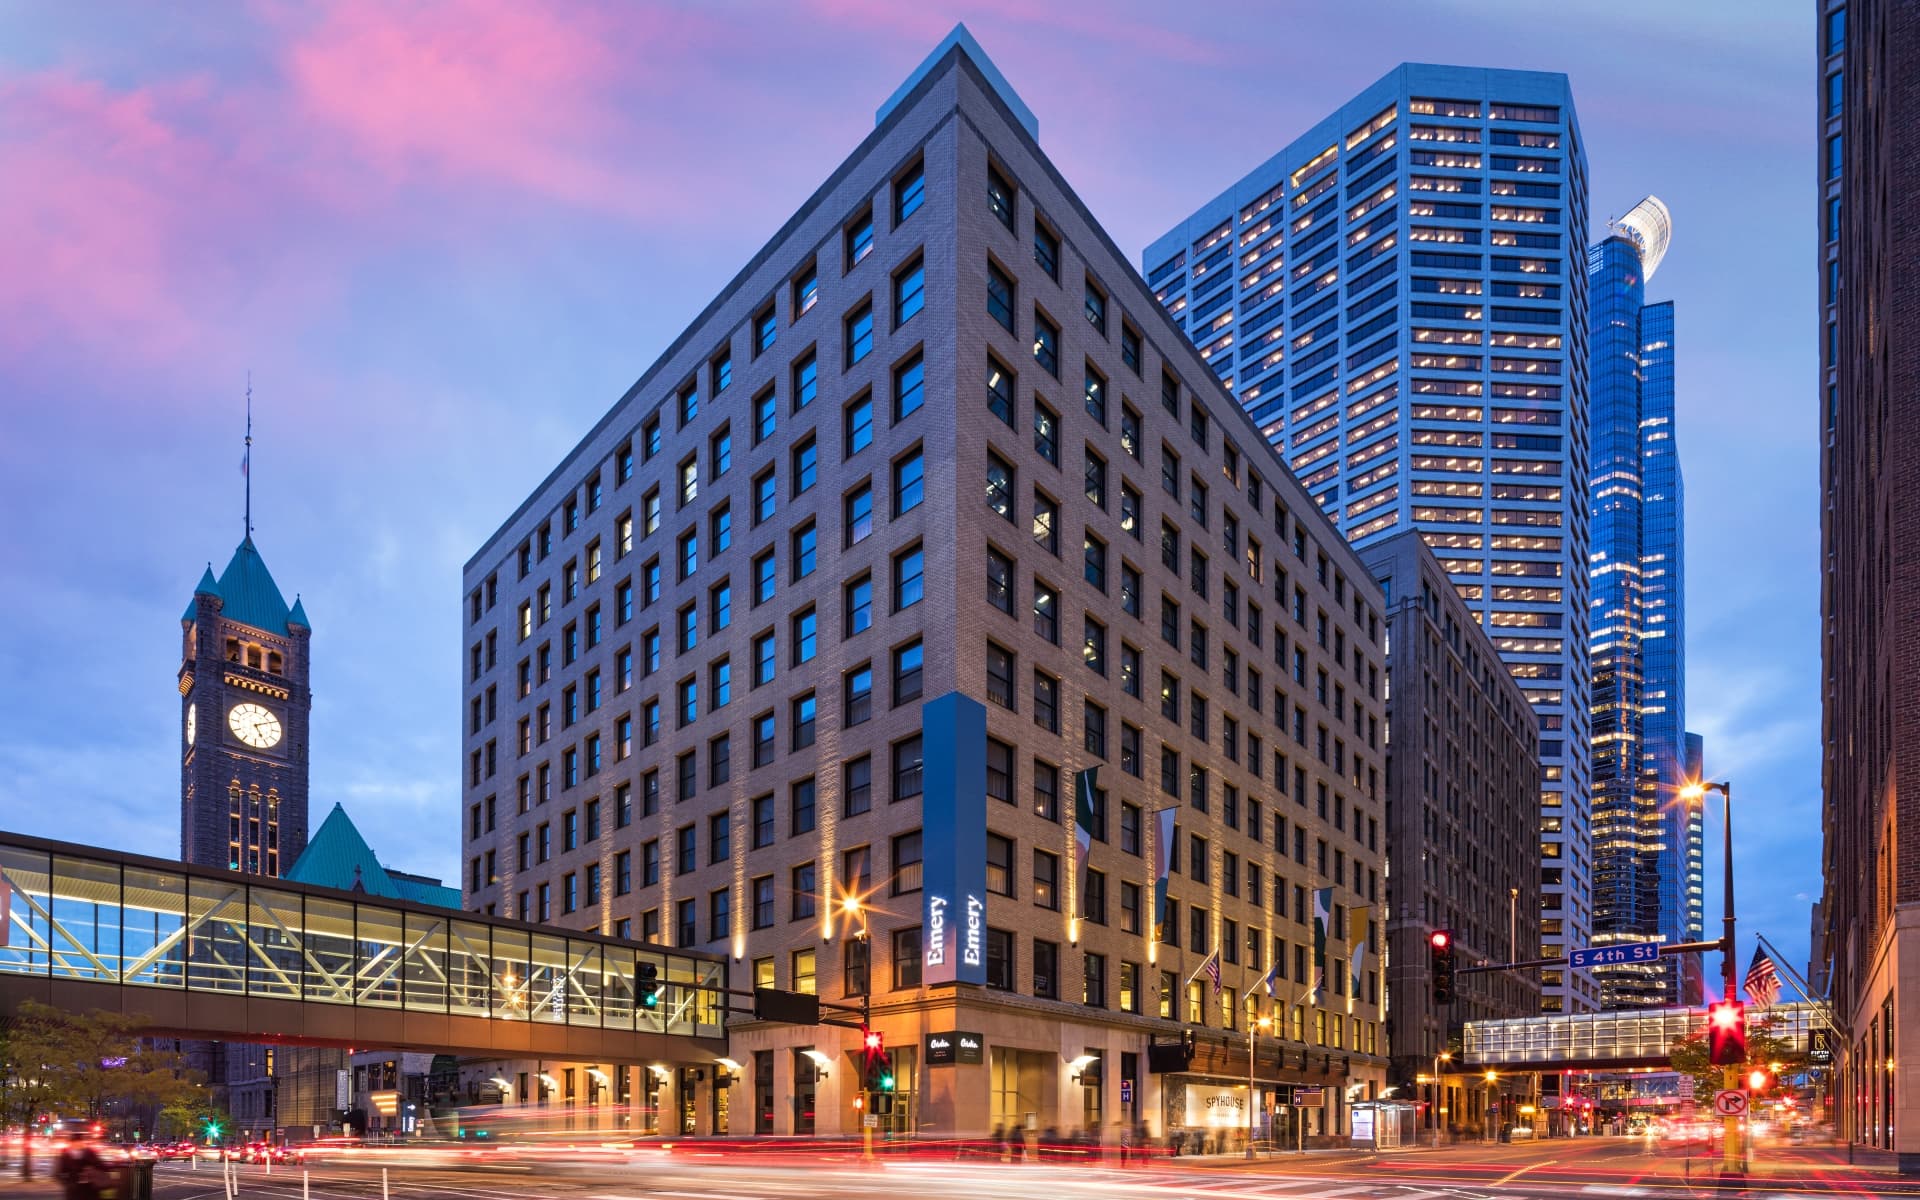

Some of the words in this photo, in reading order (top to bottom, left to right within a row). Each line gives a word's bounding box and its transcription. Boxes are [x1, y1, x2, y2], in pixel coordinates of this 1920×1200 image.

[928, 896, 947, 966] Emery
[964, 894, 983, 966] Emery
[1574, 954, 1584, 964] S
[1593, 949, 1625, 962] 4th
[1633, 946, 1653, 958] St
[1123, 1092, 1129, 1100] H
[1206, 1095, 1244, 1110] SPYHOUSE
